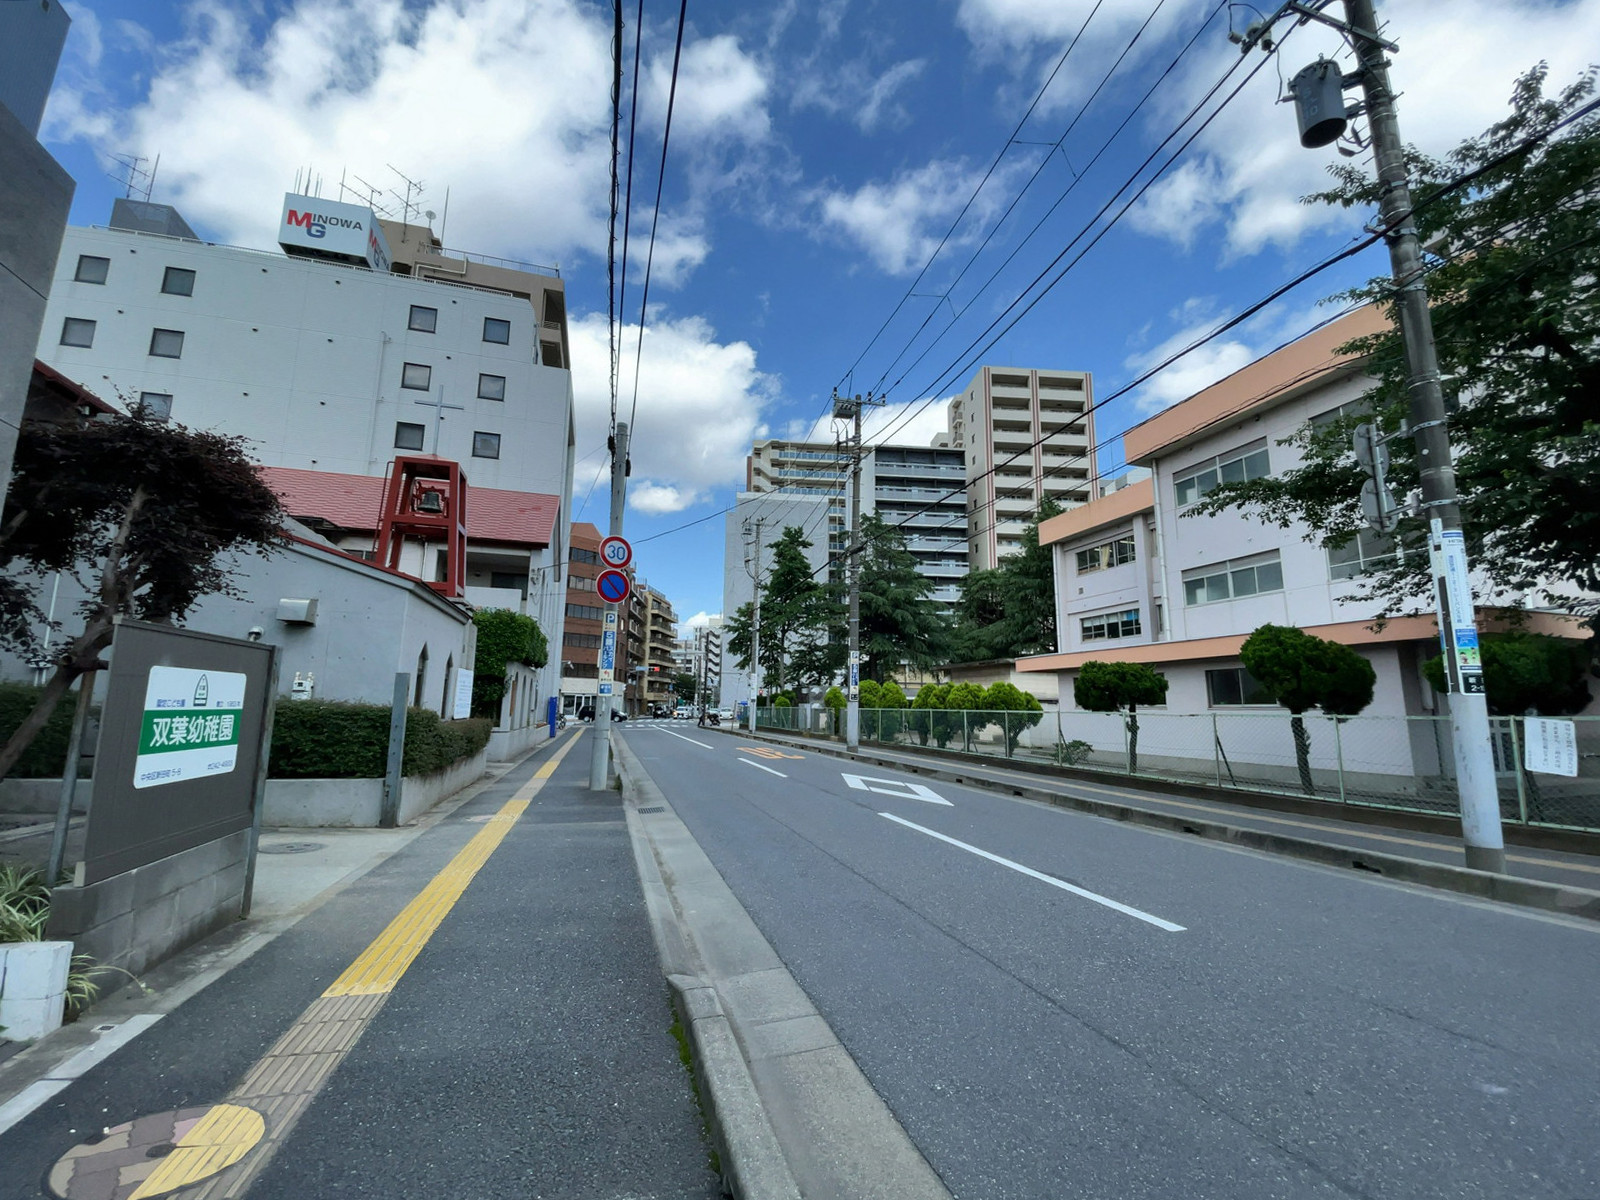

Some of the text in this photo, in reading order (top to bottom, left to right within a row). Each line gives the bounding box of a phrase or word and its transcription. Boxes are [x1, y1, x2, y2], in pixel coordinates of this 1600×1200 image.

[287, 209, 363, 231] MINOWA
[607, 544, 626, 561] 30
[149, 714, 235, 747] 双葉幼稚園
